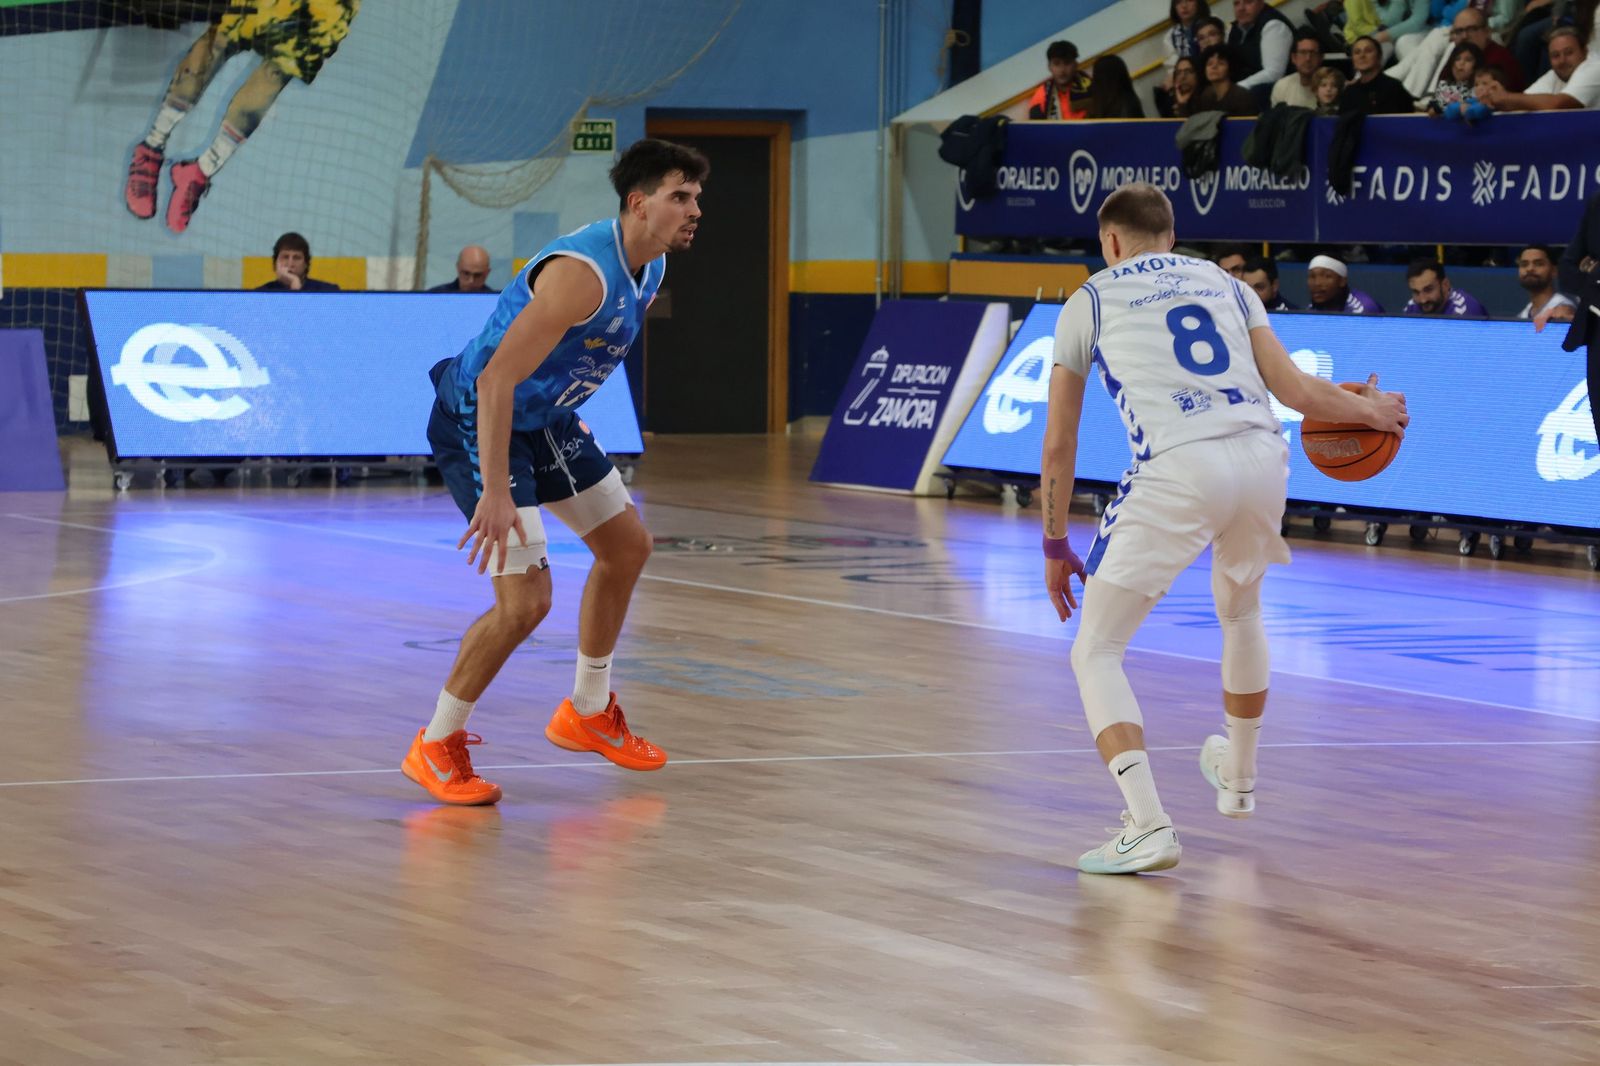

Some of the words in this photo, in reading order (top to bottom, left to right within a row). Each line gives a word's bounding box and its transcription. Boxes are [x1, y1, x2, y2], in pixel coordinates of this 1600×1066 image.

[576, 137, 609, 149] EXIT
[996, 166, 1060, 191] ORALEJO
[1101, 165, 1181, 191] MORALEJO
[1225, 165, 1311, 191] MORALEO
[1351, 166, 1452, 201] FADIS
[1166, 304, 1231, 376] 8
[868, 397, 937, 429] ZAMORA
